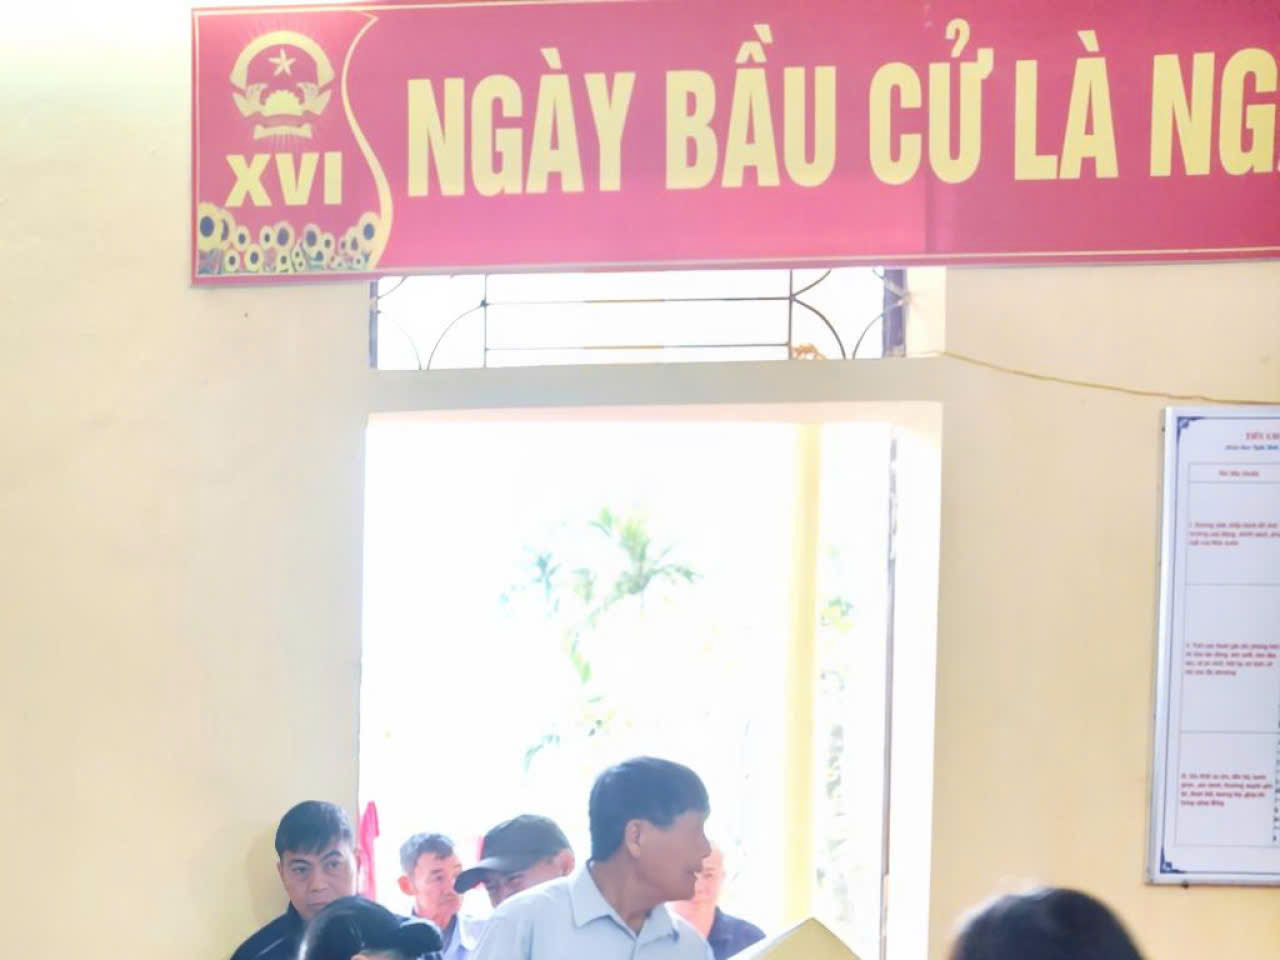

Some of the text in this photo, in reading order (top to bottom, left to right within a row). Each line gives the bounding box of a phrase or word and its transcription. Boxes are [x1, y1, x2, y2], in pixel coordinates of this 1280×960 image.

[407, 18, 1280, 197] NGÀY BẦU CỬ LÀ NG
[225, 151, 342, 207] XVI
